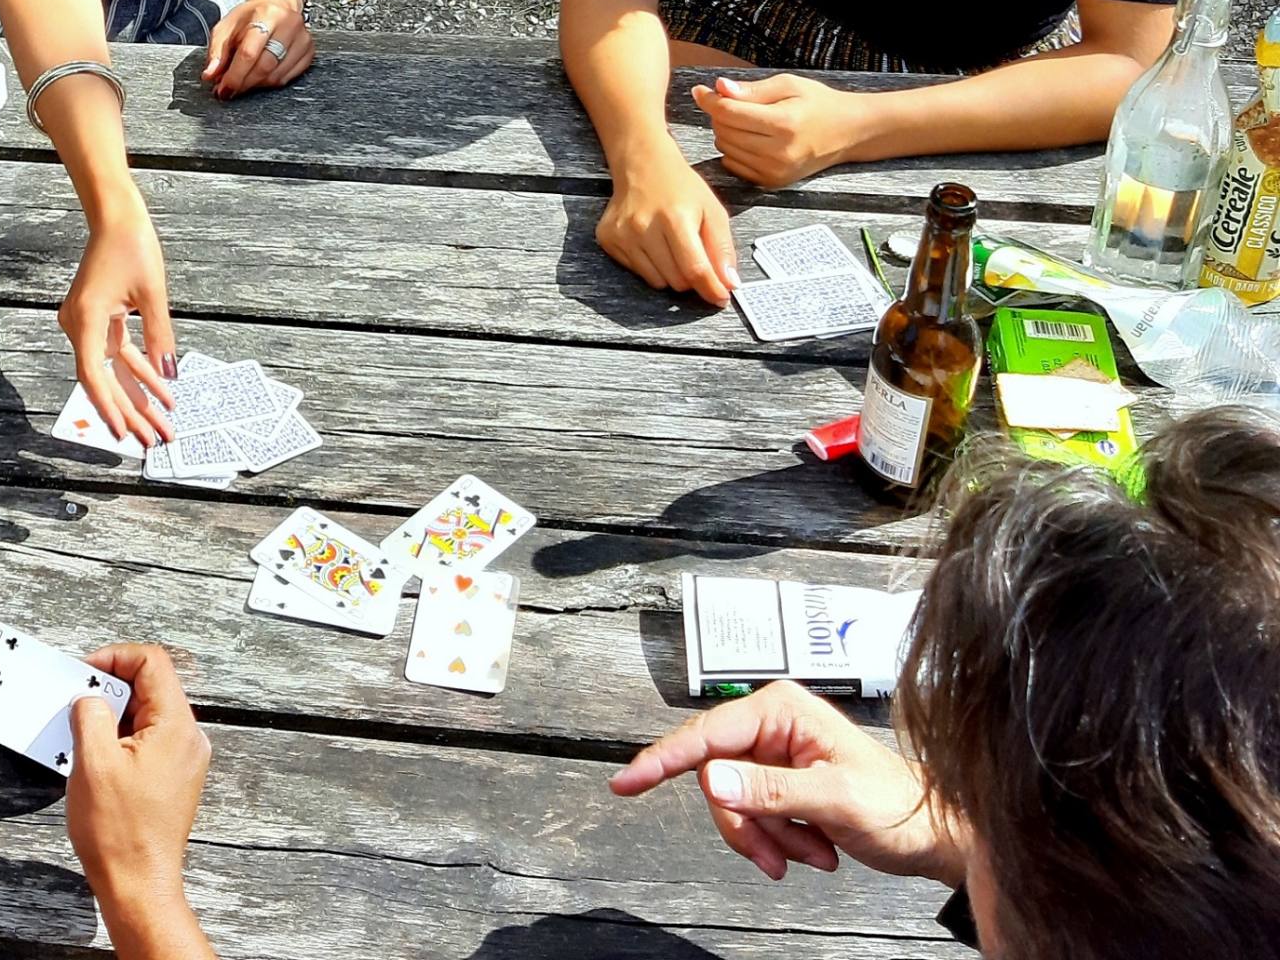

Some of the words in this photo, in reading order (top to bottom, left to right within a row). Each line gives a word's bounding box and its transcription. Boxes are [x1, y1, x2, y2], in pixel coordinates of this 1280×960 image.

[1211, 166, 1256, 251] Cereale
[1246, 196, 1277, 249] CLASSICO
[103, 680, 124, 698] 2
